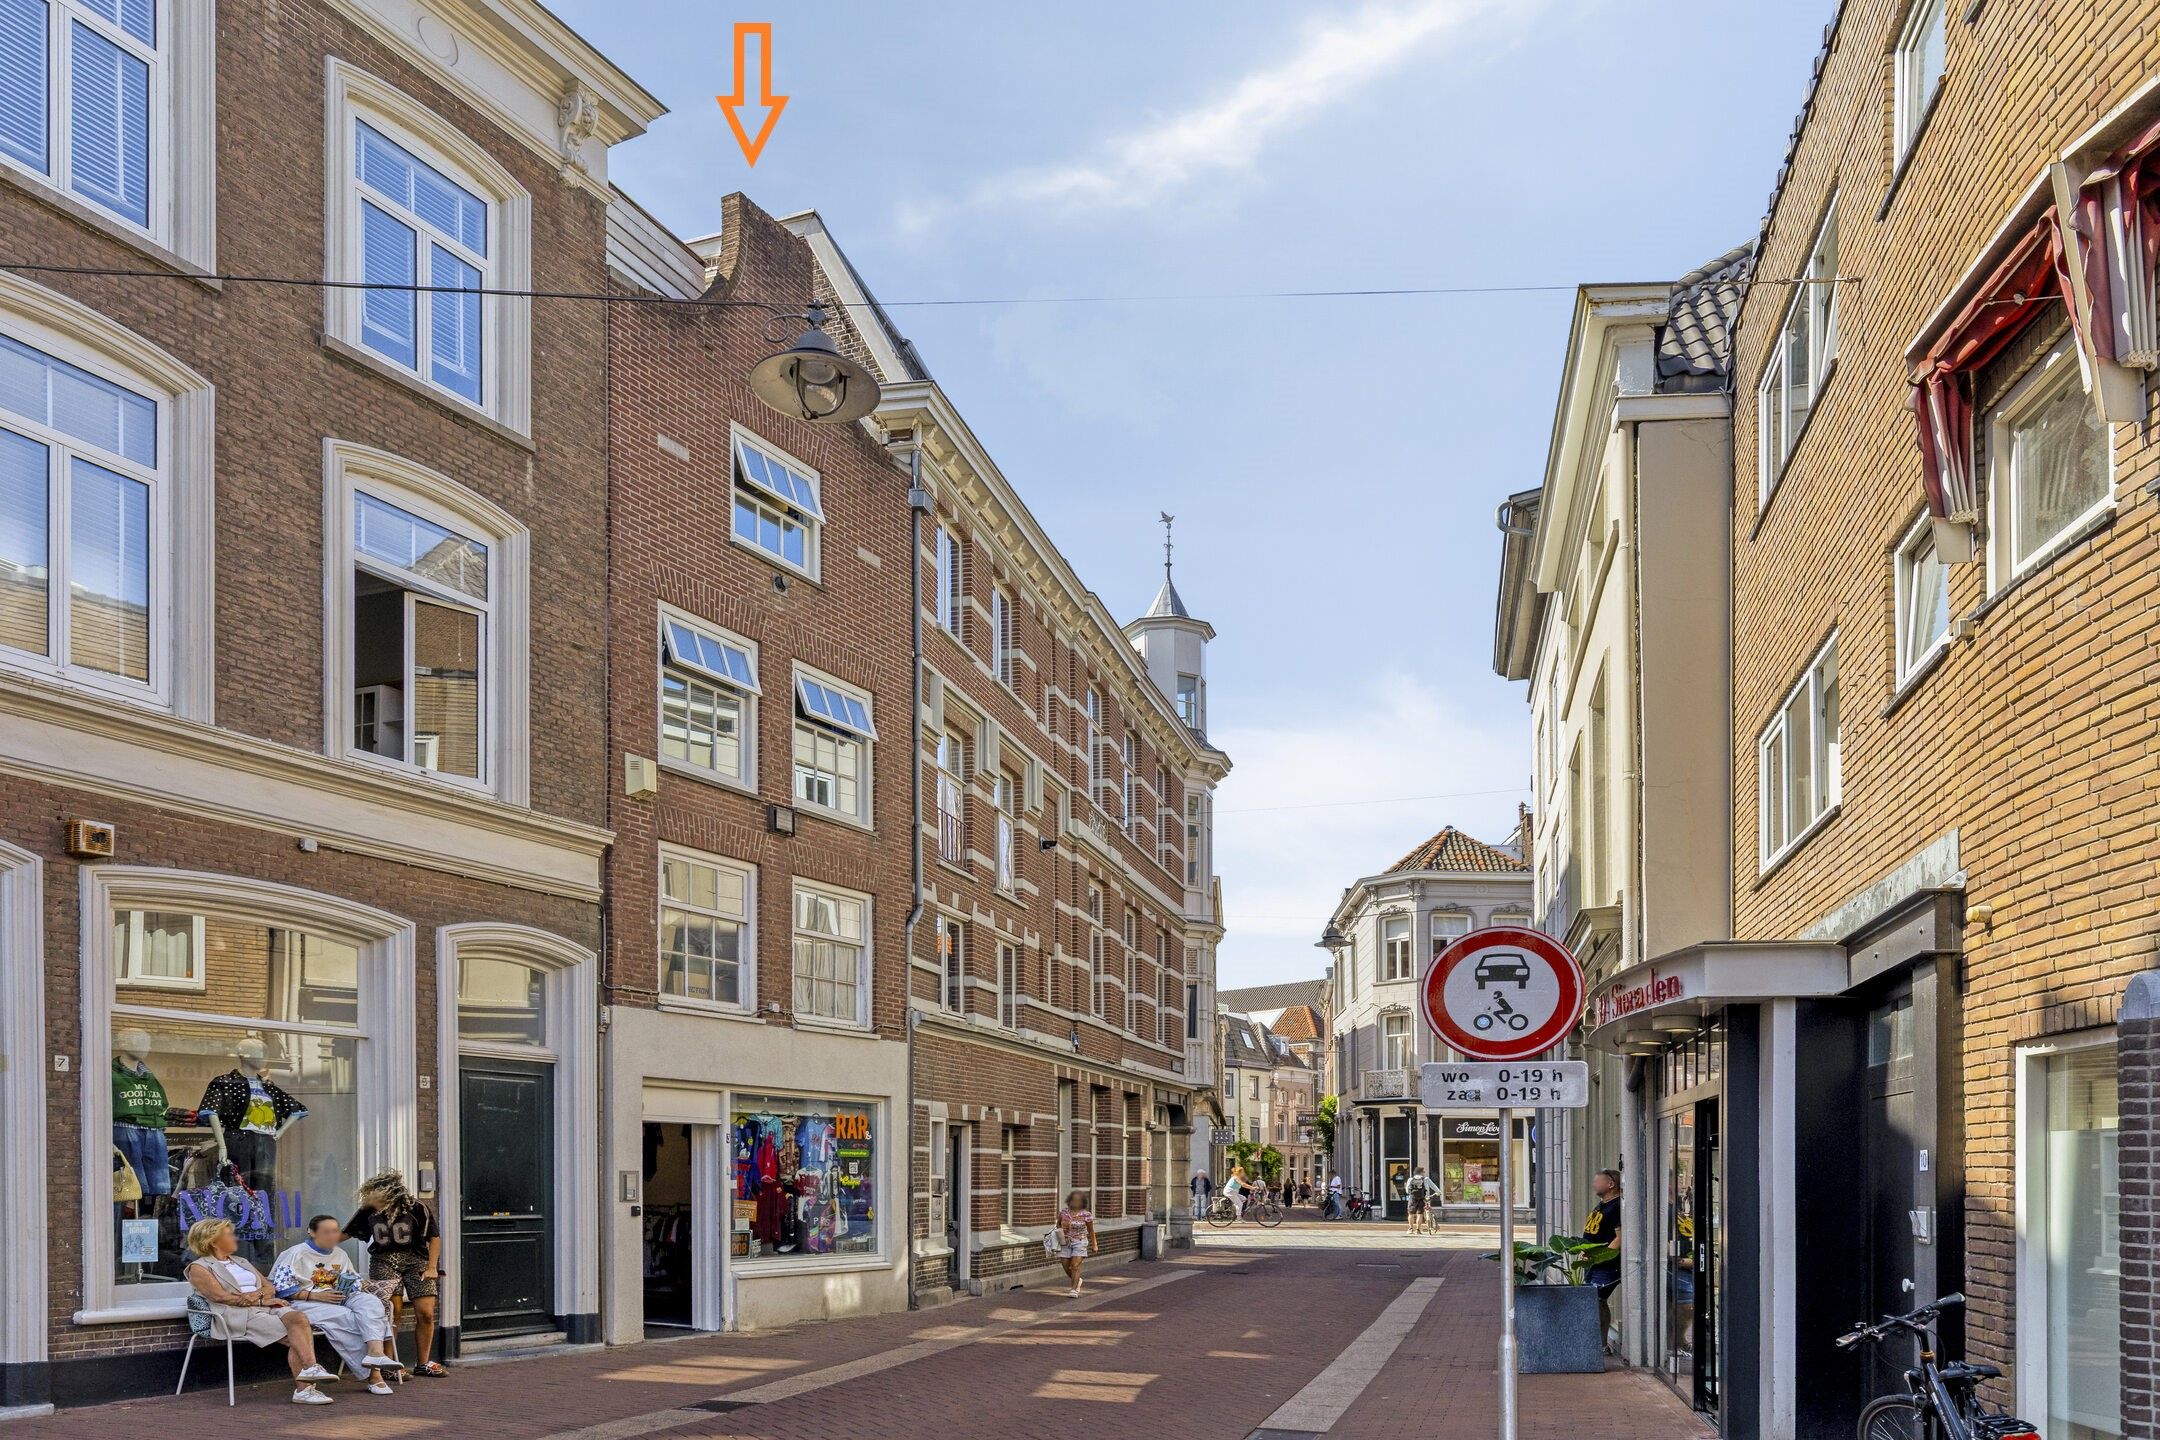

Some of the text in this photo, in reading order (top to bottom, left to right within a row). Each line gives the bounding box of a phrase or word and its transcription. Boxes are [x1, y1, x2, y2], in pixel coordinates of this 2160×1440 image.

[1612, 967, 1682, 1019] Sieraden
[57, 1057, 66, 1067] 7
[1441, 1069, 1563, 1083] wo 0-19 h
[1446, 1086, 1561, 1101] za 0-19 h
[1456, 1121, 1485, 1134] Simon
[735, 1208, 755, 1218] OPEN
[373, 1222, 410, 1246] CC
